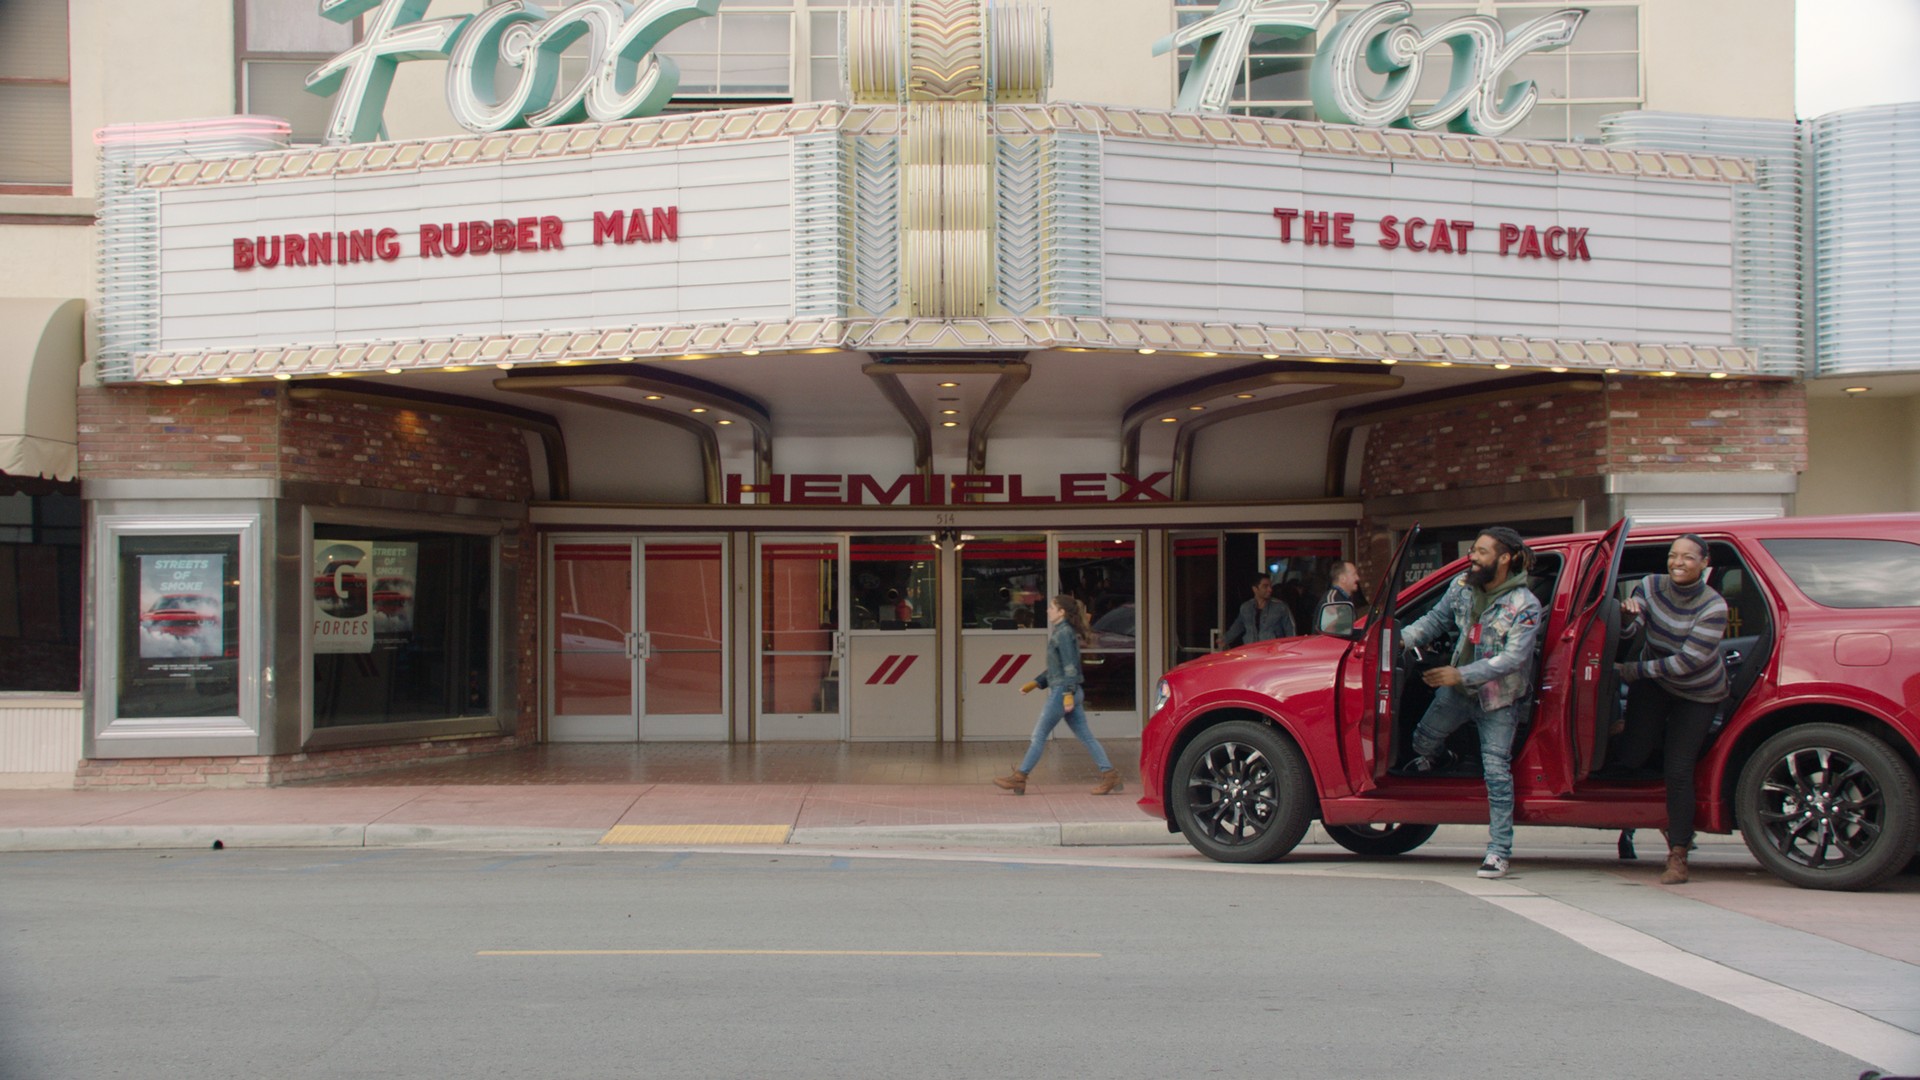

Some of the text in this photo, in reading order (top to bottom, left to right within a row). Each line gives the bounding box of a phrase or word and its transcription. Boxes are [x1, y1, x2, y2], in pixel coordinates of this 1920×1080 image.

[232, 205, 678, 271] BURNING RUBBER MAN
[1273, 207, 1592, 262] THE SCAT PACK
[726, 472, 1172, 504] HEMIPLEX
[936, 513, 955, 525] 514
[372, 547, 407, 556] STREETS
[154, 560, 209, 569] STREETS
[384, 557, 397, 566] OF
[172, 571, 191, 580] OF
[375, 567, 404, 575] SMOKE
[160, 581, 204, 591] SMOKE
[313, 620, 368, 635] FORCES
